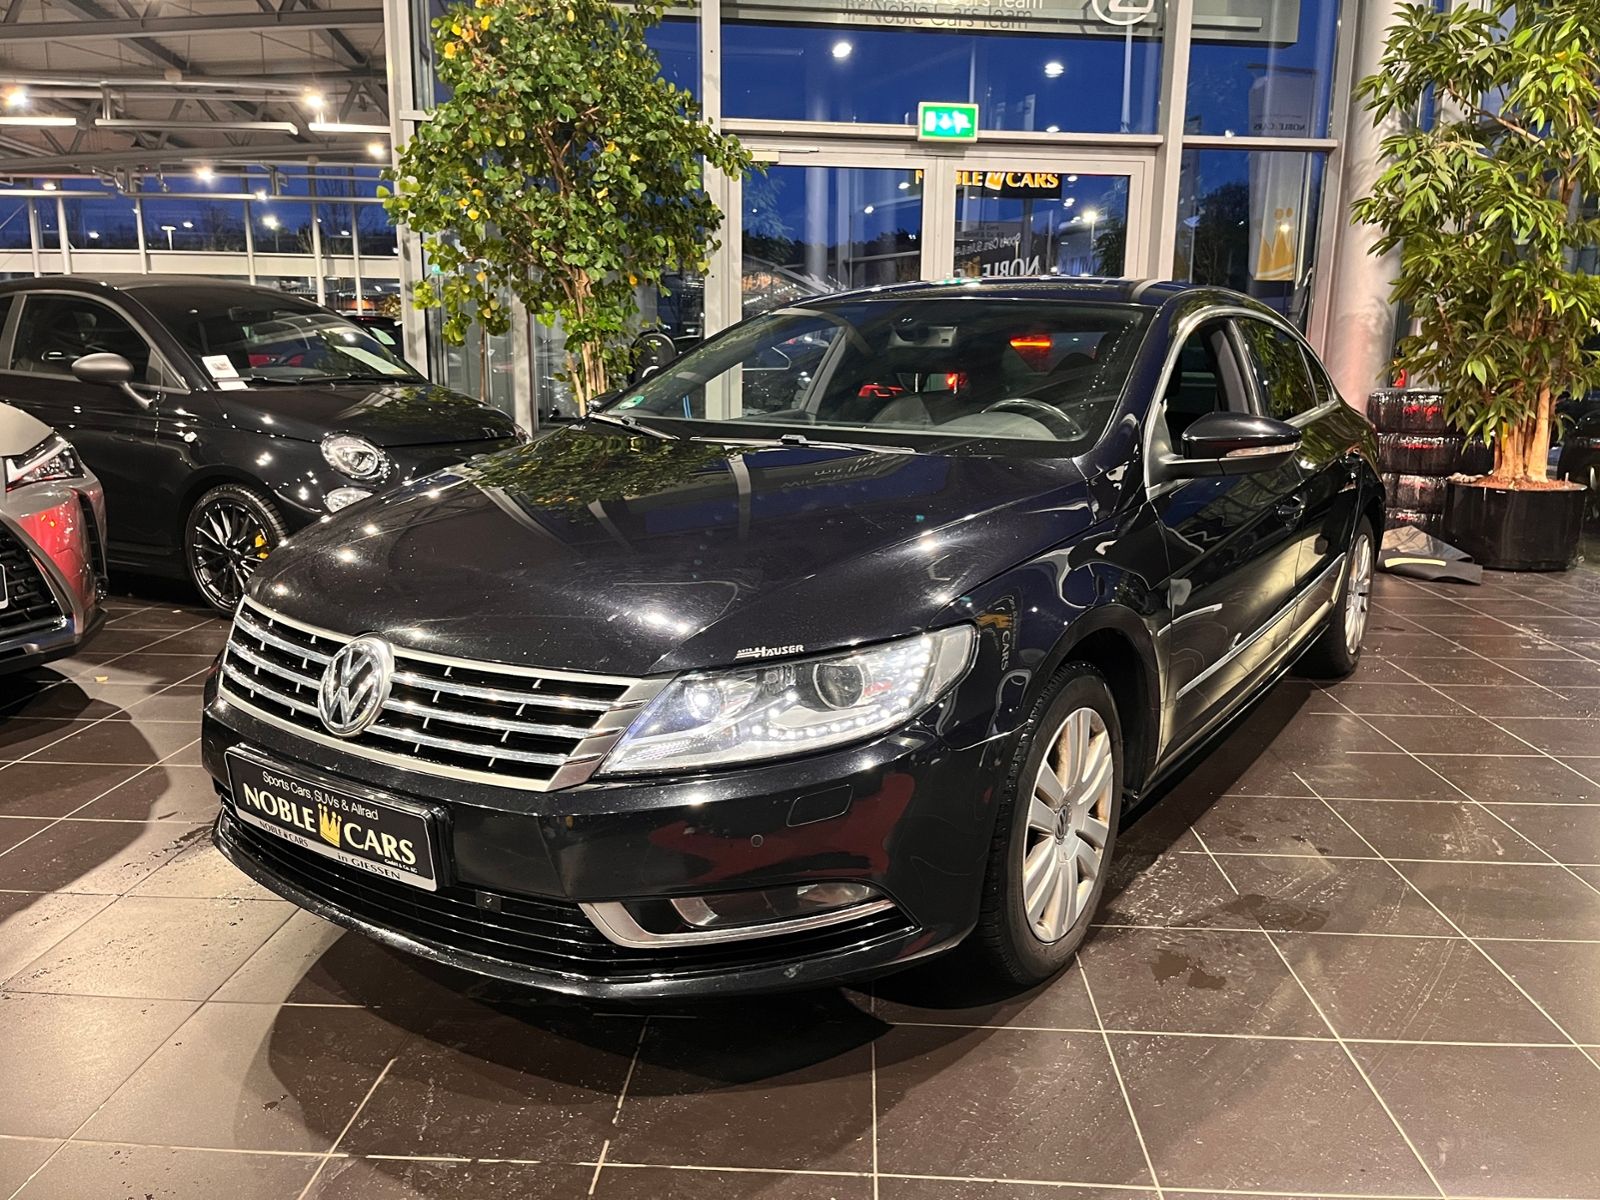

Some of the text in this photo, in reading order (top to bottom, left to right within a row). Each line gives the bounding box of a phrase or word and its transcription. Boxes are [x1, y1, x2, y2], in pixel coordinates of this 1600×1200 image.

[1005, 171, 1059, 188] CARS
[262, 770, 290, 791] Sports
[314, 790, 340, 809] SUVs
[341, 800, 349, 811] &
[351, 802, 379, 820] Allrad
[243, 783, 416, 865] NOBLE CARS
[259, 820, 309, 848] NOBLE CARS
[337, 852, 401, 879] in GIESSEN
